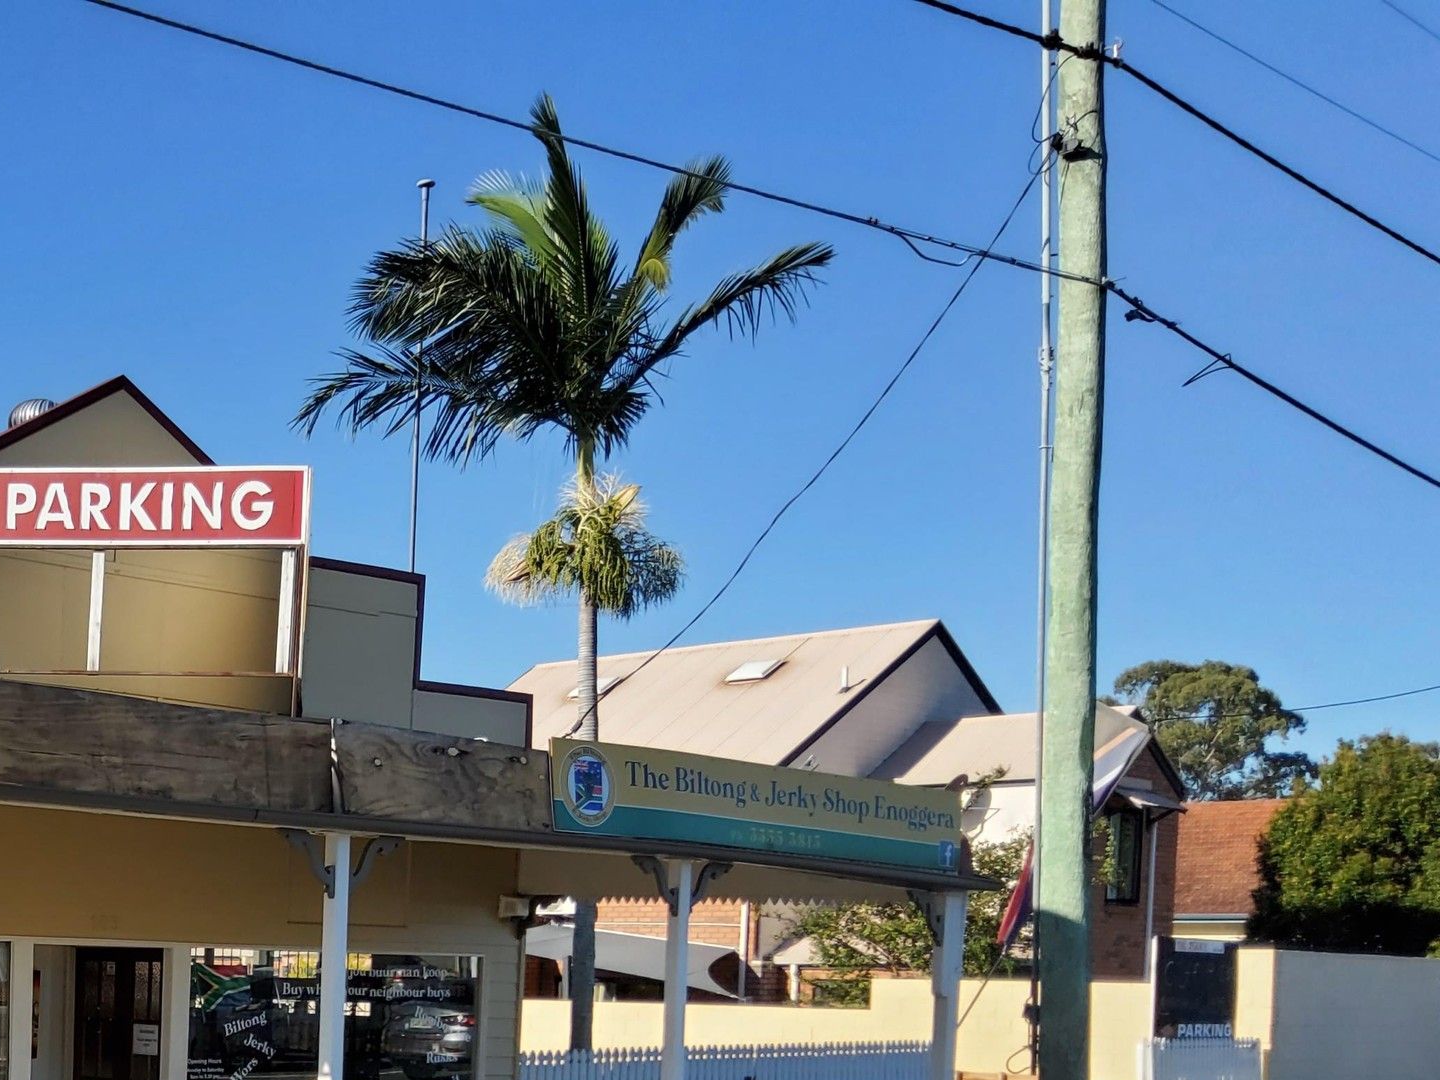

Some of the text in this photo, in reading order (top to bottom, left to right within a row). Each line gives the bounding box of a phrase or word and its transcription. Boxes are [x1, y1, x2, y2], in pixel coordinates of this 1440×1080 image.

[5, 480, 275, 532] PARKING
[624, 760, 955, 832] The Biltong & Jerky Shop Enoggera
[422, 966, 448, 982] koop
[282, 982, 304, 999] Buy
[346, 986, 368, 996] our
[369, 984, 425, 1000] neighbour
[427, 985, 451, 1001] buys
[223, 1010, 268, 1037] Biltong
[1177, 1023, 1233, 1037] PARKING
[243, 1033, 277, 1060] Jerky
